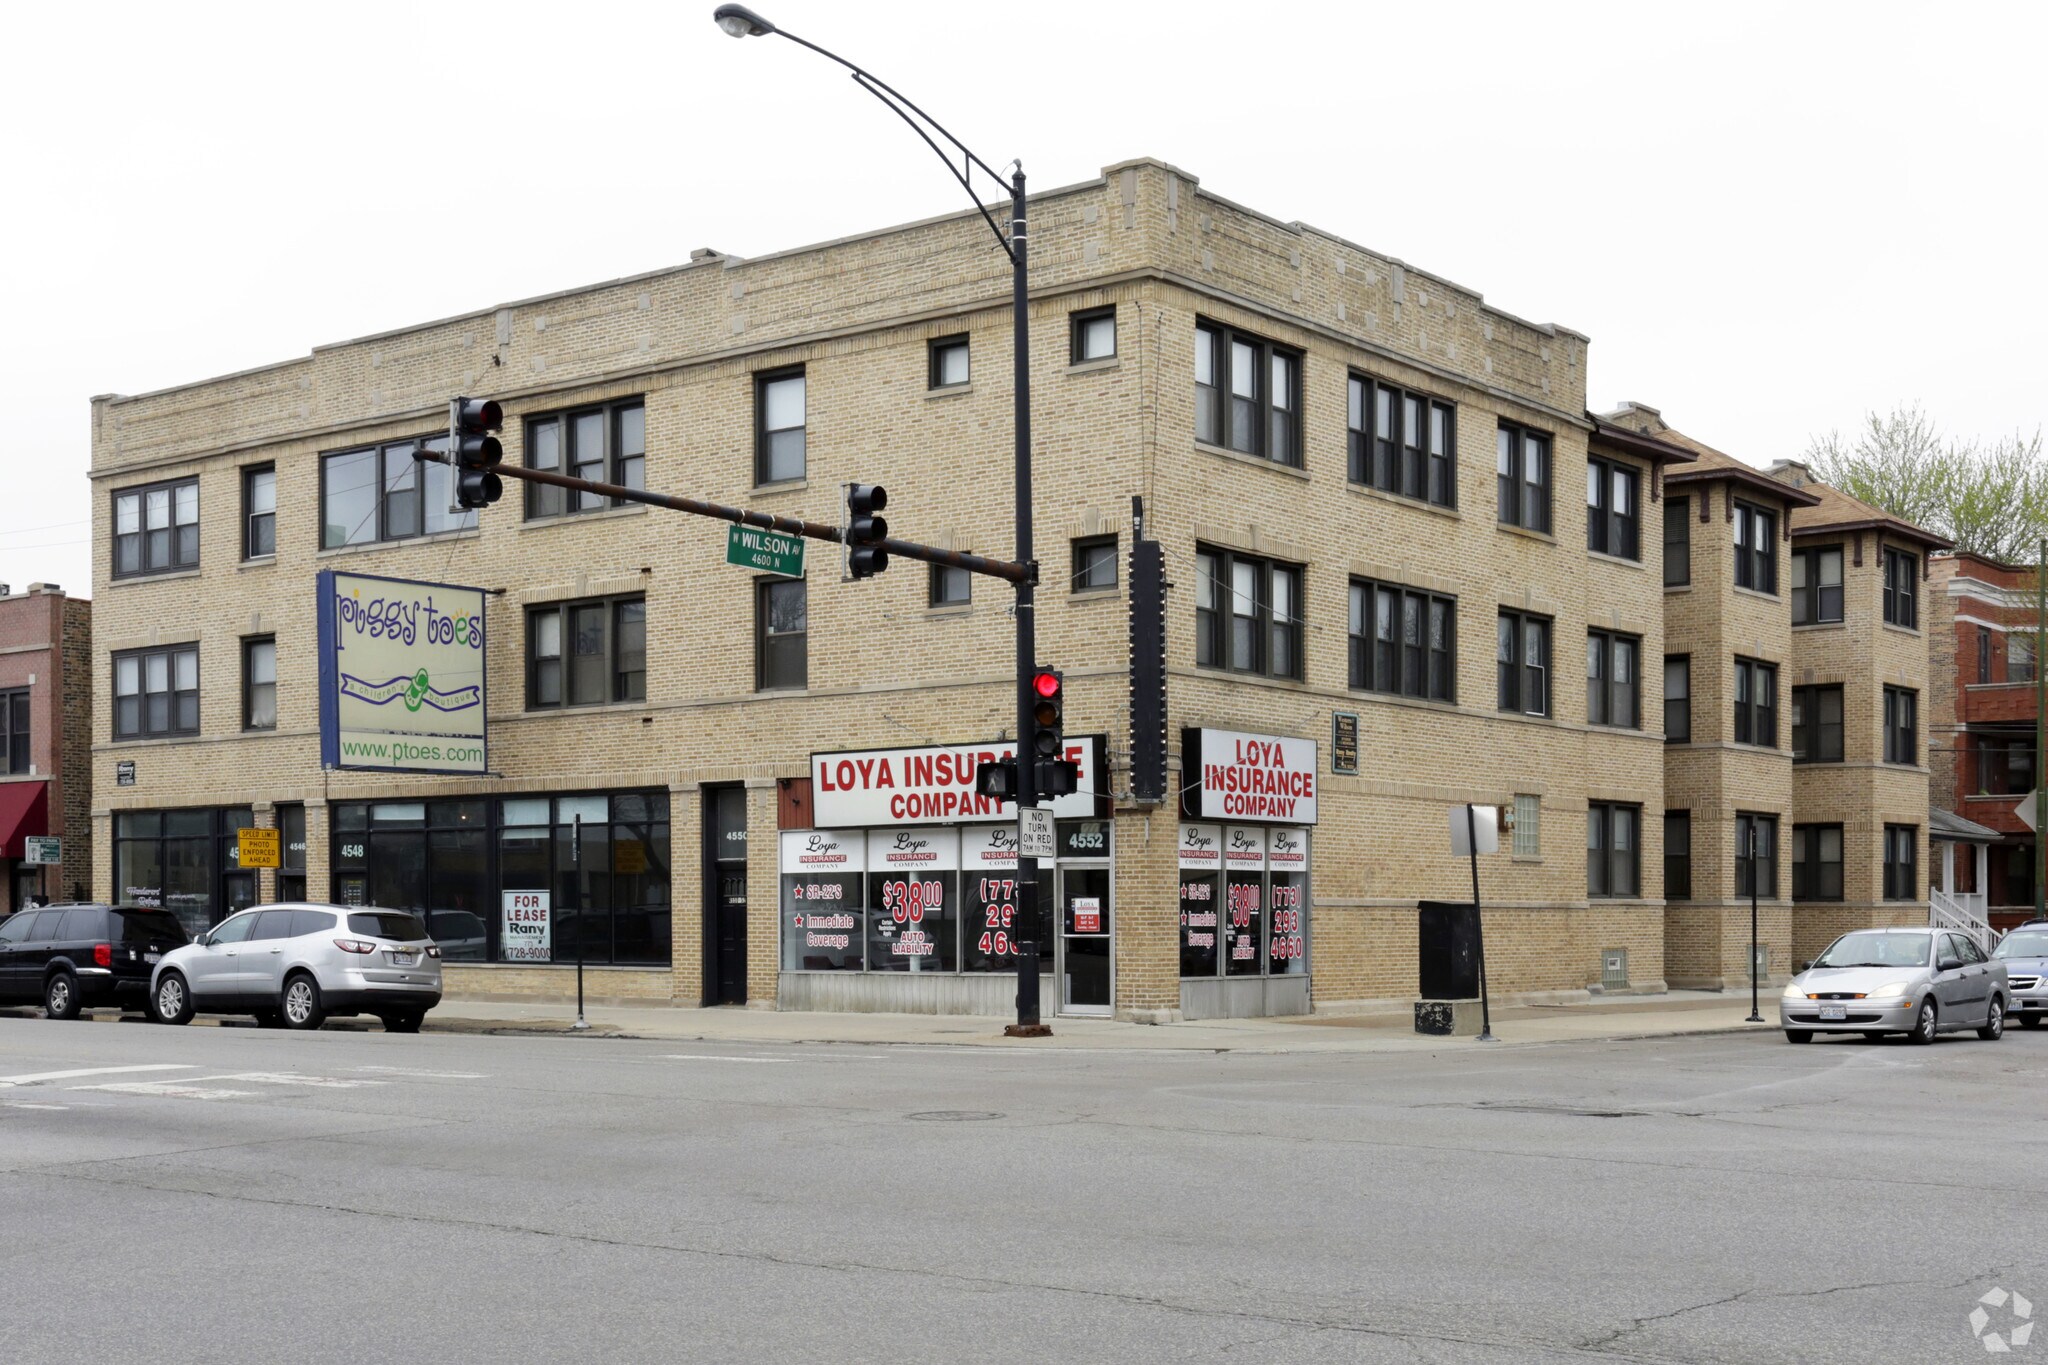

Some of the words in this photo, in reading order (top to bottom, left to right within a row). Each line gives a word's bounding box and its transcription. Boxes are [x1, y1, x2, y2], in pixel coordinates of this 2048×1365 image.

[733, 532, 739, 543] W
[742, 532, 790, 556] WILSON
[792, 545, 801, 555] AV
[752, 553, 772, 566] 4600
[774, 557, 780, 568] N
[336, 588, 420, 651] piggy
[423, 595, 482, 650] toes
[350, 683, 355, 691] a
[359, 683, 405, 701] children's
[429, 692, 472, 707] boutique
[342, 741, 483, 766] www.ptoes.com
[1236, 739, 1285, 769] LOYA
[820, 757, 895, 792] LOYA
[904, 745, 1084, 788] INSUE
[1205, 764, 1313, 798] INSURANCE
[1224, 793, 1297, 818] COMPANY
[1031, 812, 1044, 822] NO
[242, 830, 260, 838] SPEED
[261, 830, 276, 838] LIMIT
[1028, 823, 1048, 833] TURN
[806, 834, 840, 855] Loya
[893, 832, 930, 853] Loya
[1024, 833, 1034, 844] ON
[1037, 834, 1052, 844] RED
[1069, 833, 1104, 849] 4552
[1185, 828, 1213, 850] Loya
[1231, 830, 1257, 852] Loya
[1274, 832, 1300, 853] Loya
[341, 844, 364, 858] 4548
[800, 855, 847, 863] INSURANCE
[886, 852, 937, 862] INSURANCE
[1179, 850, 1218, 858] INSURANCE
[1226, 851, 1262, 860] INSURANCE
[1270, 853, 1304, 861] INSURANCE
[806, 884, 842, 900] SR-22'S
[1272, 884, 1301, 909] (773)
[514, 896, 539, 907] FOR
[507, 909, 547, 921] LEASE
[806, 914, 854, 929] Immediate
[986, 904, 1015, 928] 29
[1274, 910, 1299, 933] 293
[509, 922, 545, 938] Rany
[900, 931, 925, 943] AUTO
[806, 932, 849, 949] Coverage
[892, 942, 934, 955] LIABILITY
[1270, 936, 1303, 960] 4660
[508, 947, 550, 959] 728-9000
